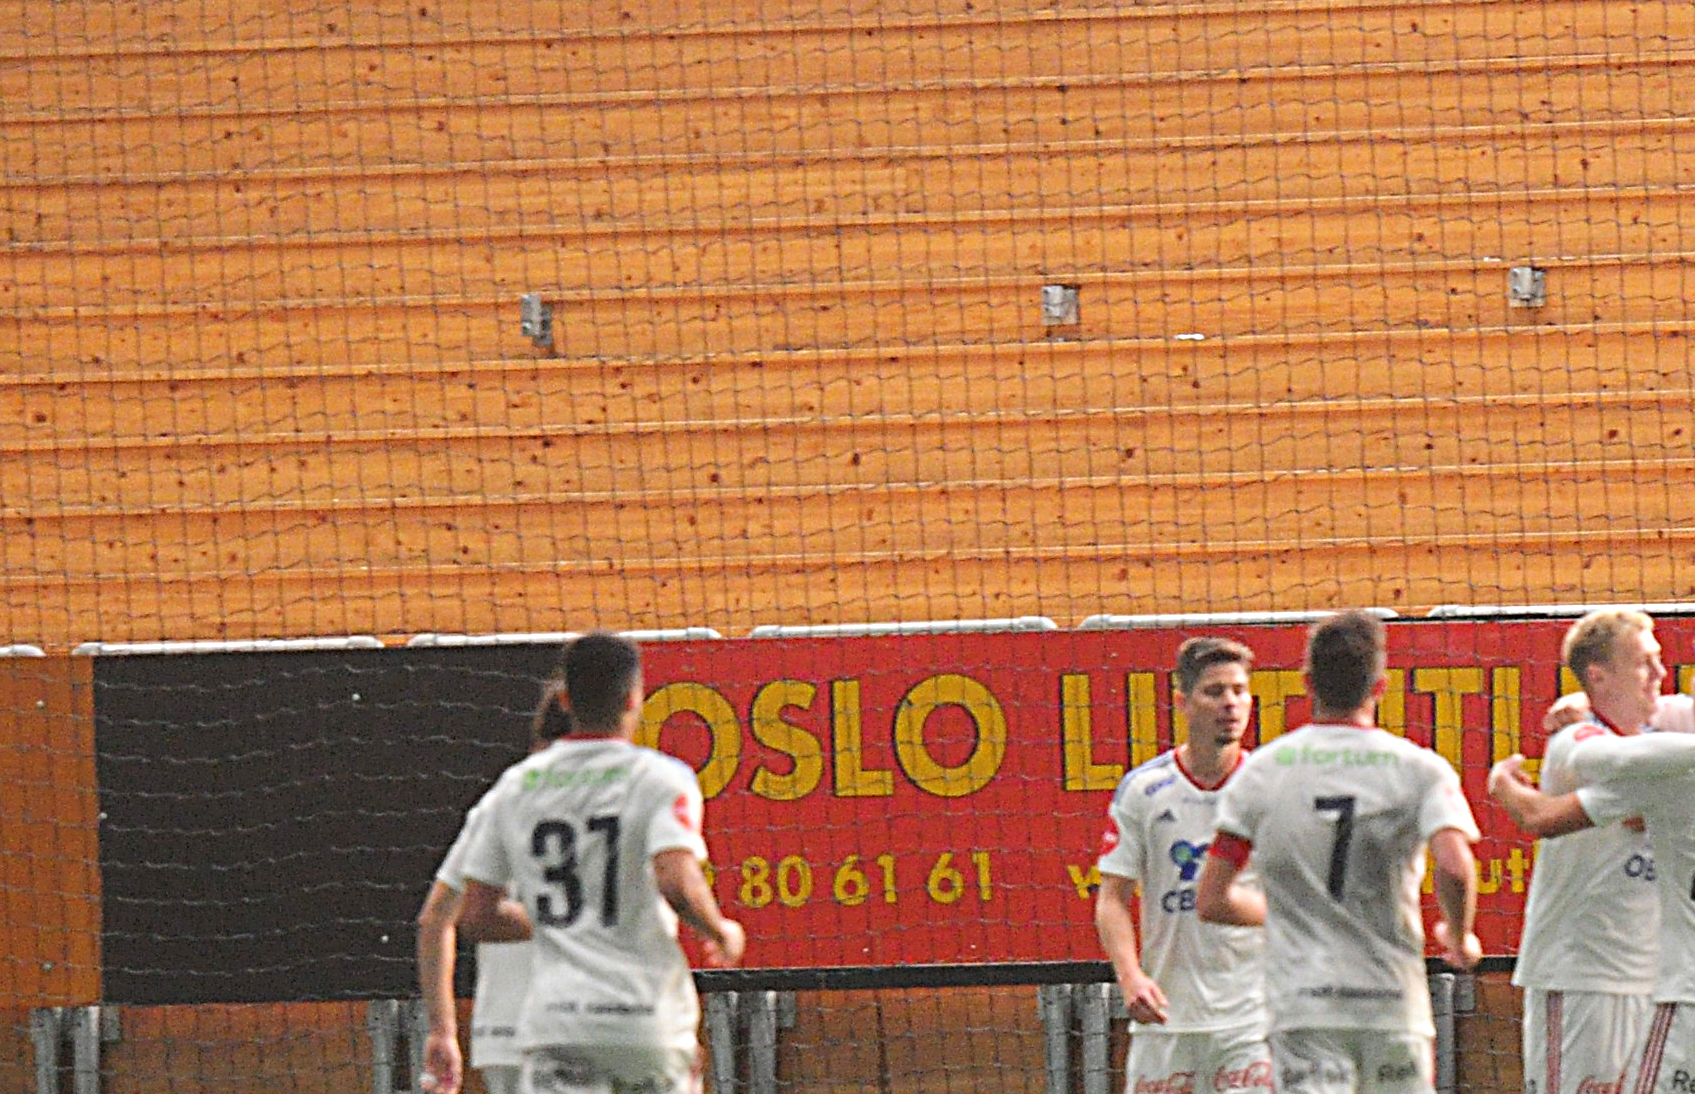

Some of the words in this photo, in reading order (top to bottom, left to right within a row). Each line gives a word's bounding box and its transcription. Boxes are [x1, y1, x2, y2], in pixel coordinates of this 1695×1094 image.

[634, 673, 1008, 801] OSLO
[531, 816, 620, 929] 37
[738, 854, 813, 908] 80
[832, 853, 898, 906] 61
[926, 850, 993, 904] 61
[1314, 795, 1355, 901] 7
